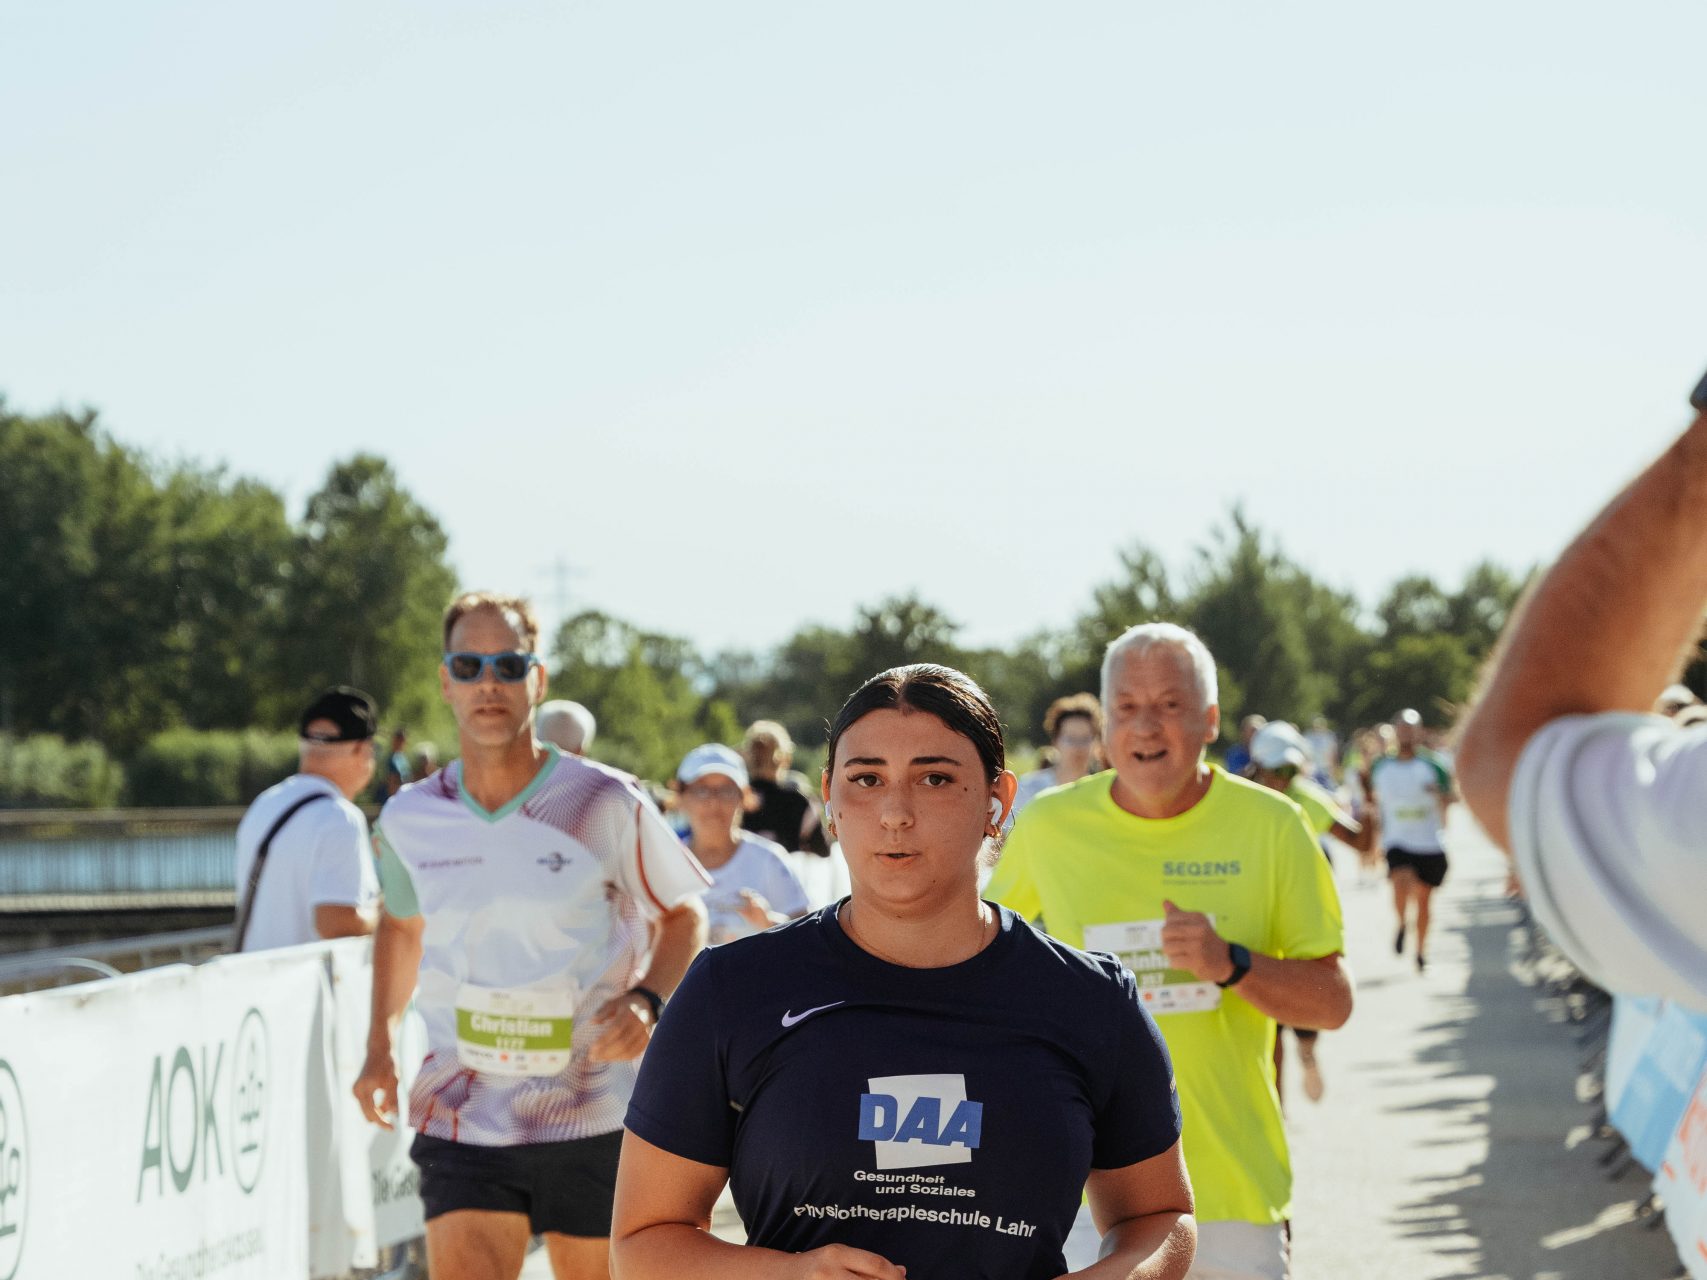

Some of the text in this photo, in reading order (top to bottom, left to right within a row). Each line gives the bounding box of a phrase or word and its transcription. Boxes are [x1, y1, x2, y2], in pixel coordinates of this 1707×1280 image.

[471, 1012, 553, 1037] Christian
[137, 1042, 224, 1203] AOK
[858, 1093, 983, 1148] DAA
[854, 1171, 945, 1184] Gesundheit
[876, 1184, 976, 1197] und Soziales
[794, 1204, 1036, 1238] Physiotherapieschule Lahr
